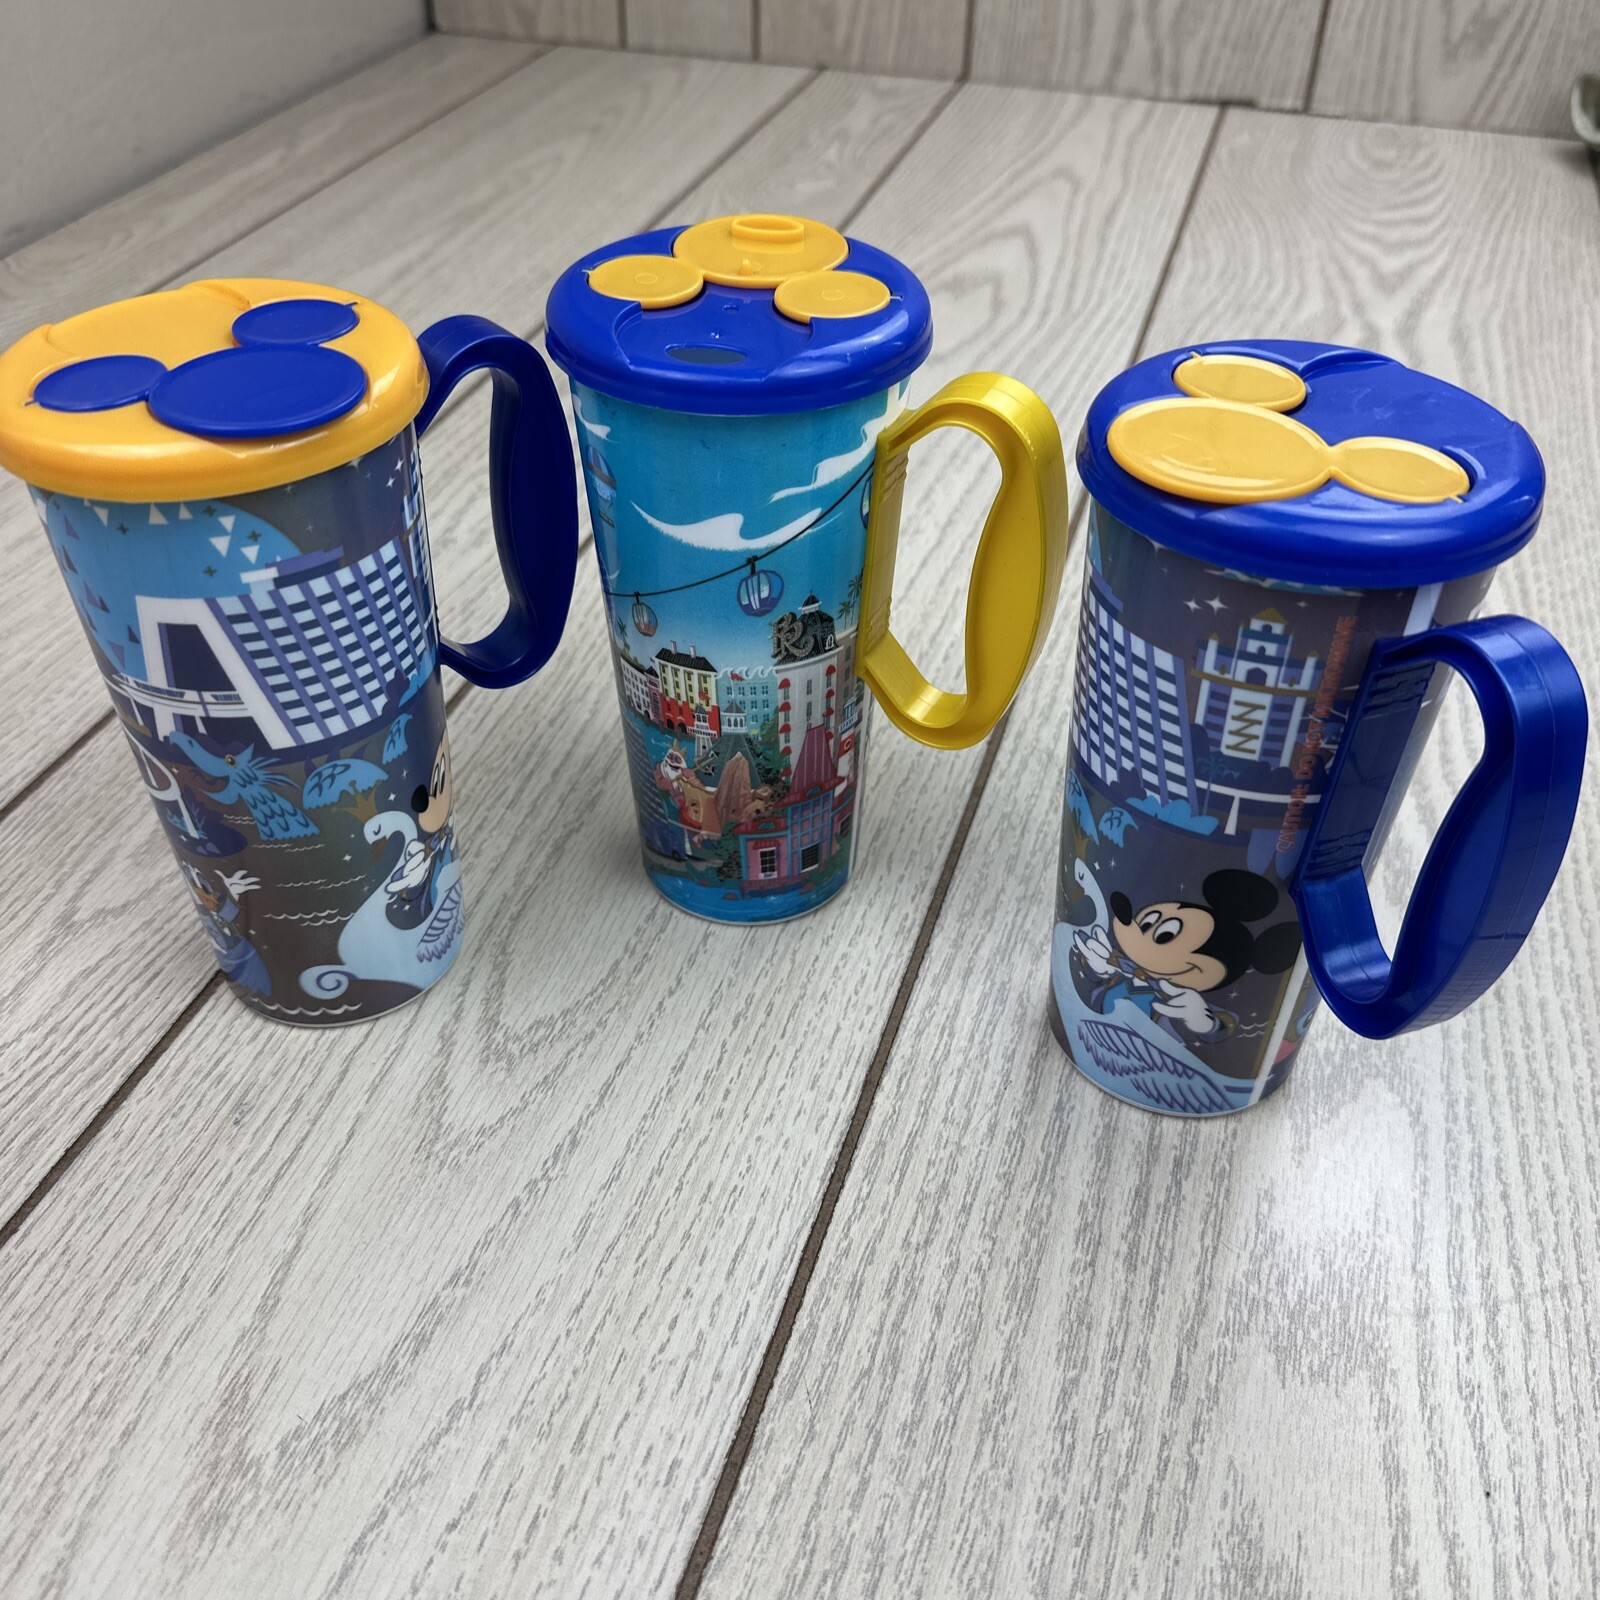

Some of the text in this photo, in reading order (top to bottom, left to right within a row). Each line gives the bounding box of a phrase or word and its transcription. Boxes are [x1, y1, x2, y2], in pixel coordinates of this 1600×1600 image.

[1276, 616, 1358, 852] CAUTION: DO NOT MICROWAVE
